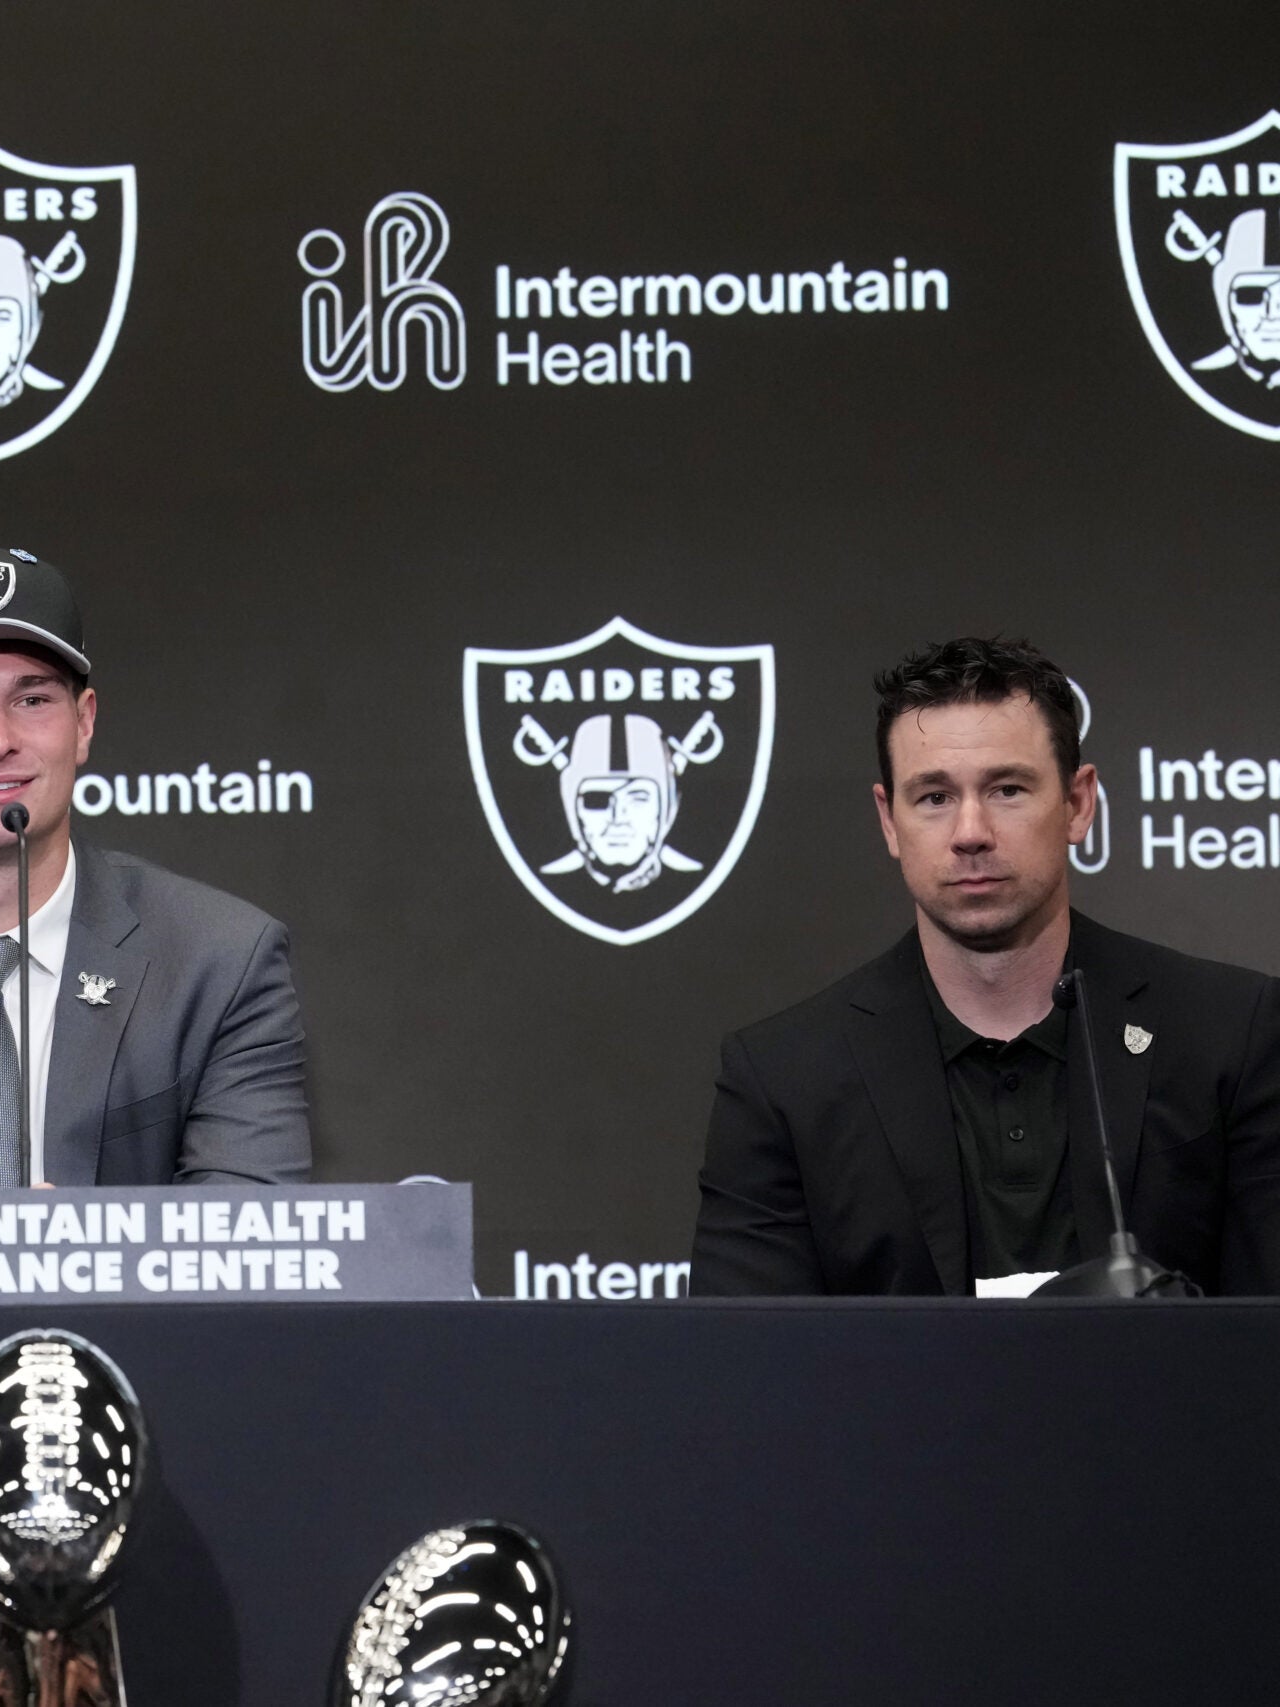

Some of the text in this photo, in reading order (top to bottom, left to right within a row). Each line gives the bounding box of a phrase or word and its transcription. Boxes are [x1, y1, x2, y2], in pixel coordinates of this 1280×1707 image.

[495, 256, 949, 320] Intermountain
[496, 328, 692, 386] Health
[503, 666, 736, 704] RAIDERS
[160, 1199, 367, 1244] HEALTH
[136, 1248, 343, 1293] CENTER
